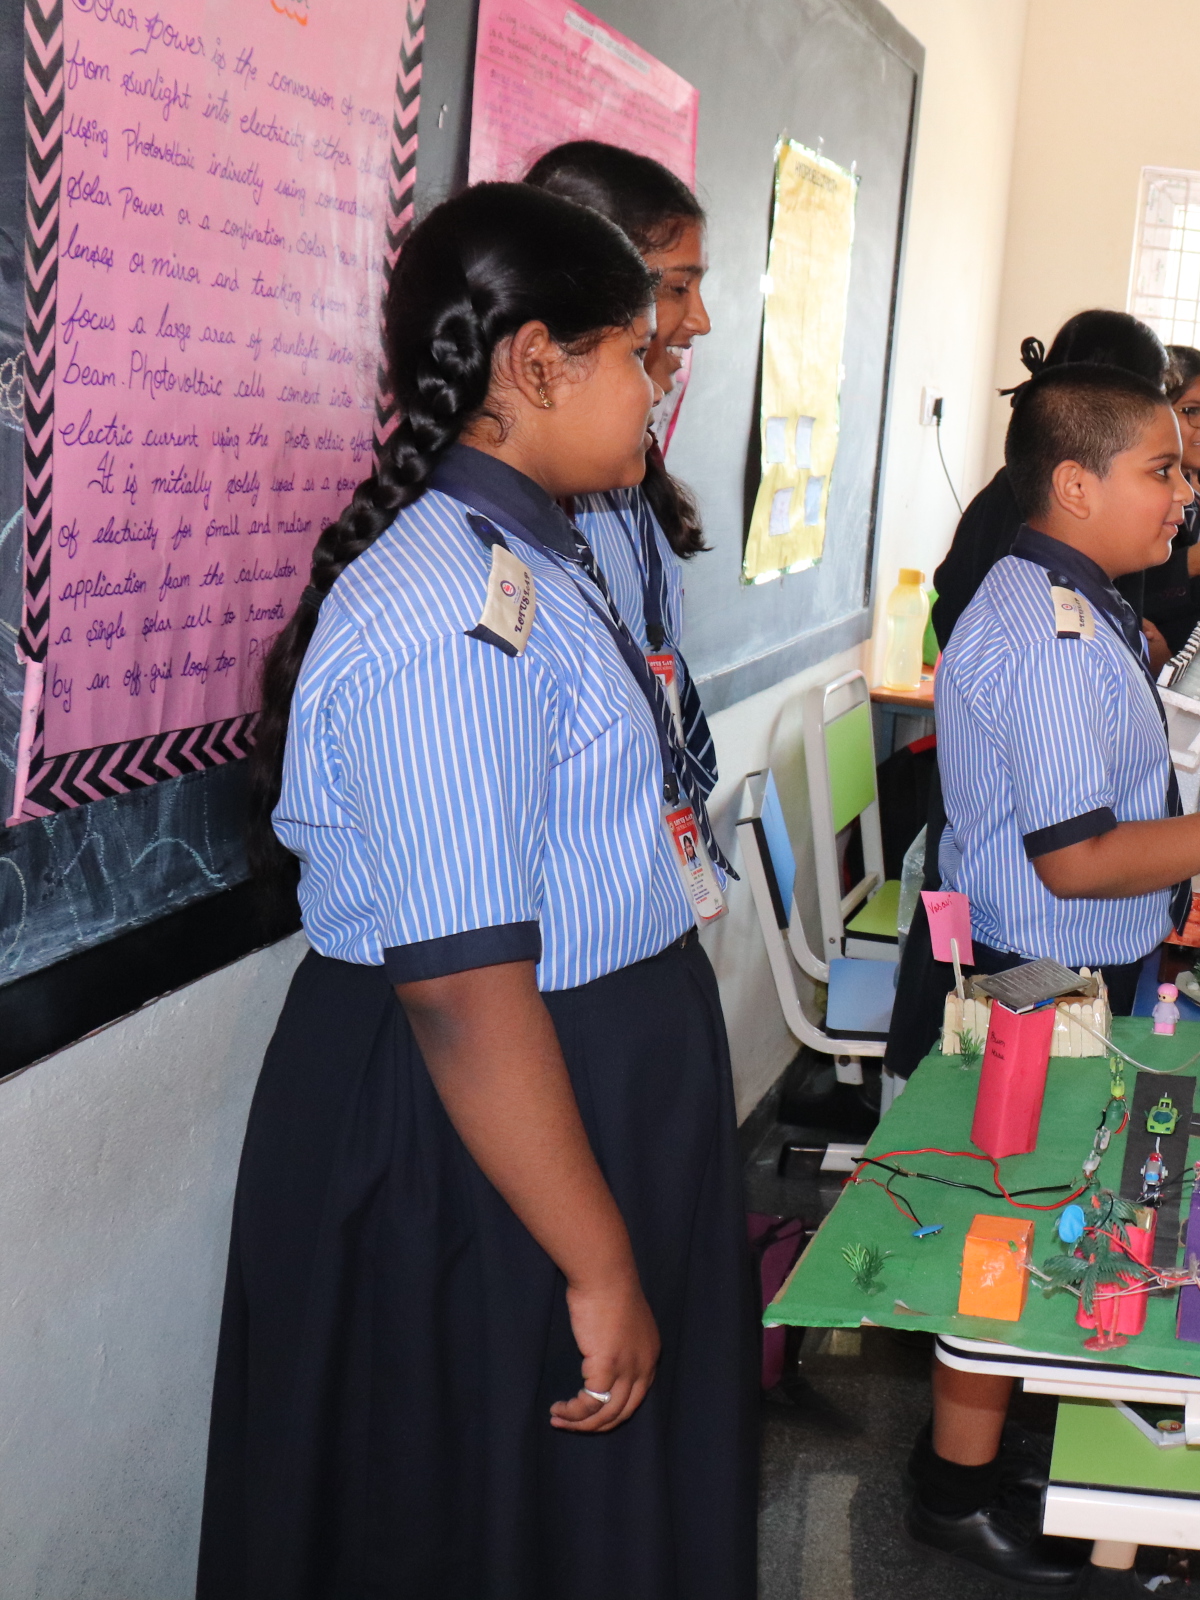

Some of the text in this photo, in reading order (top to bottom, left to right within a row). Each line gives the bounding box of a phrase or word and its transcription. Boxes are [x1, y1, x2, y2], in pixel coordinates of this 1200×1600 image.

[66, 39, 111, 90] from
[202, 89, 230, 123] into
[240, 106, 304, 161] electricity
[233, 46, 257, 91] the
[341, 95, 353, 125] of
[198, 215, 210, 230] a
[211, 267, 239, 291] and
[251, 270, 301, 316] tracking
[61, 292, 115, 344] focus
[129, 316, 146, 334] a
[156, 302, 191, 352] large
[198, 326, 236, 344] area
[246, 327, 262, 361] of
[129, 350, 223, 400] Photovoltaic
[233, 370, 265, 398] cells
[58, 408, 133, 446] electric
[141, 424, 199, 448] current
[246, 422, 269, 448] the
[123, 463, 138, 505] is
[92, 516, 159, 550] electricity
[171, 515, 192, 550] for
[247, 513, 271, 535] and
[59, 568, 147, 611] application
[199, 561, 224, 587] the
[233, 558, 298, 583] calculator
[55, 626, 72, 645] a
[181, 604, 212, 629] cell
[221, 602, 236, 626] to
[52, 663, 73, 713] by
[86, 673, 110, 690] an
[213, 650, 236, 678] top
